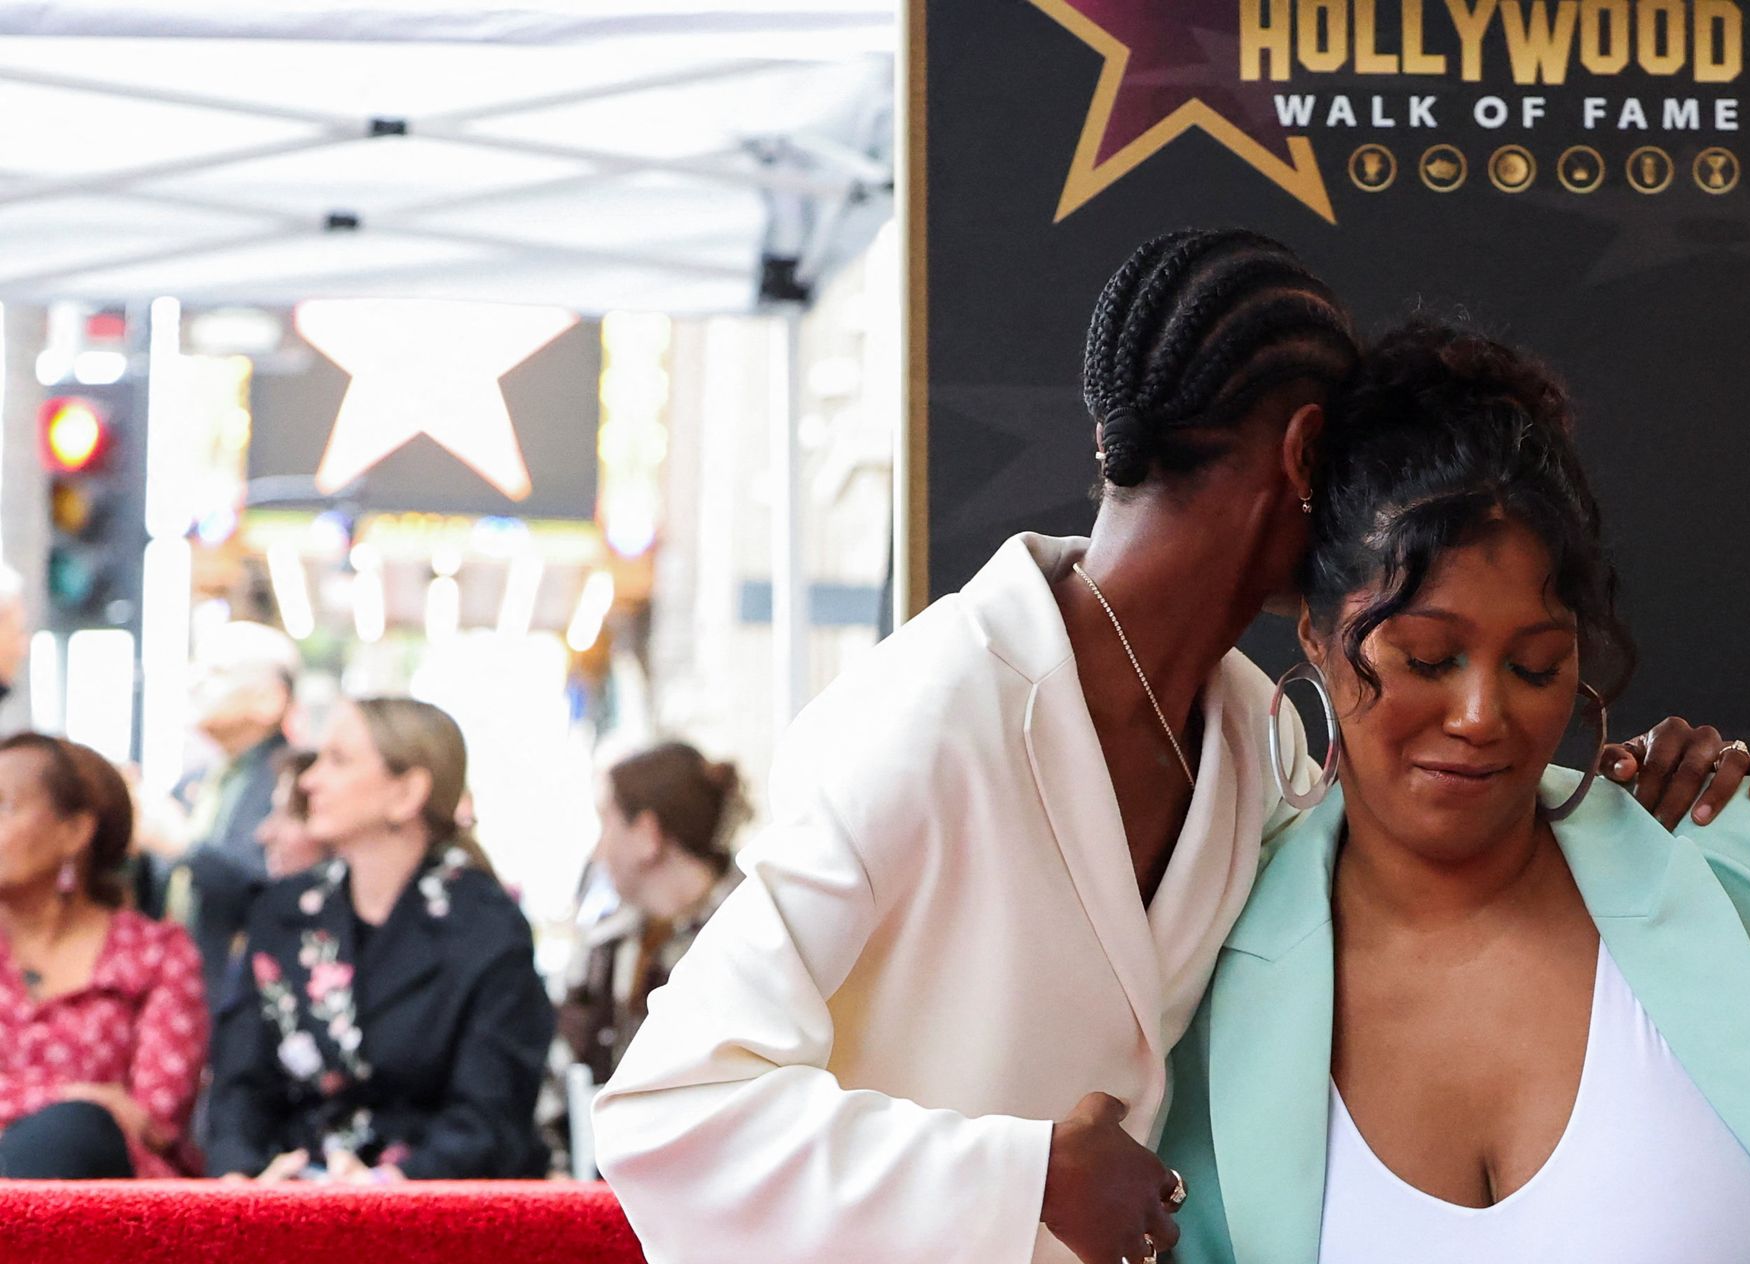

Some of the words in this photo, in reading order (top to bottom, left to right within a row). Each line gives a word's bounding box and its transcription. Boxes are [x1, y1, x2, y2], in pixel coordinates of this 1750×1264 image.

[1239, 0, 1743, 85] HOLLYWOOD
[1274, 95, 1438, 128] WALK
[1473, 95, 1546, 129] OF
[1584, 98, 1739, 130] FAME
